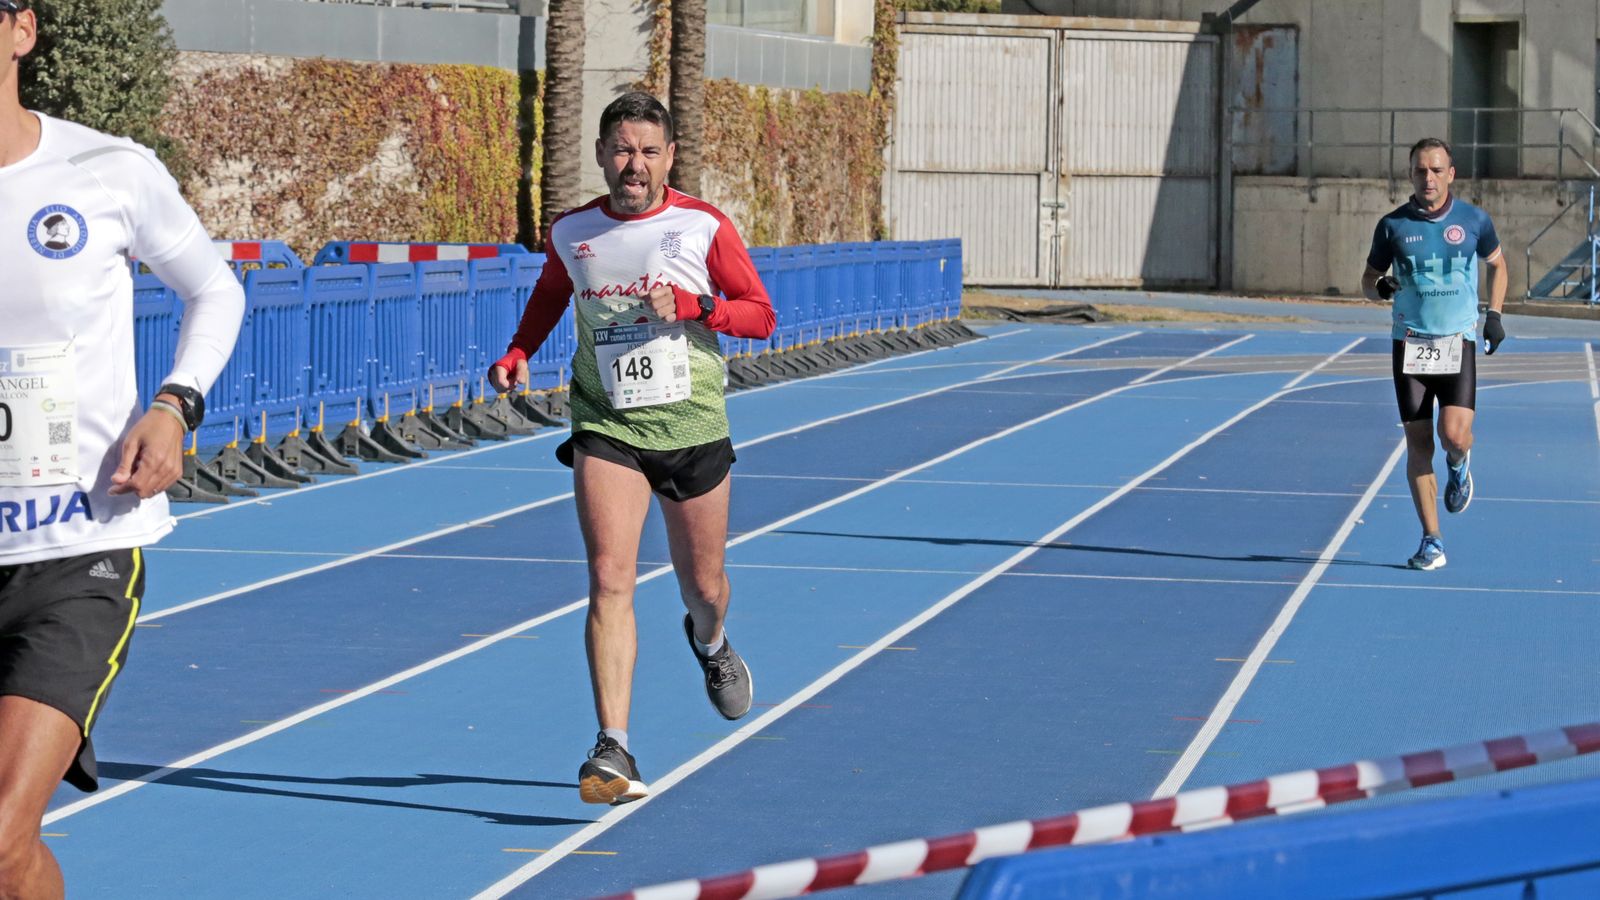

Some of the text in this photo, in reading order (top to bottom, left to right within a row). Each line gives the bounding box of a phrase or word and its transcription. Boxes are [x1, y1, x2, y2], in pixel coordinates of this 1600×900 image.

[28, 205, 88, 259] ELIO ANTONIO DE NEBRIJA
[595, 330, 609, 342] XXV
[1416, 346, 1441, 361] 233
[612, 356, 653, 382] 148
[89, 569, 120, 579] adidas
